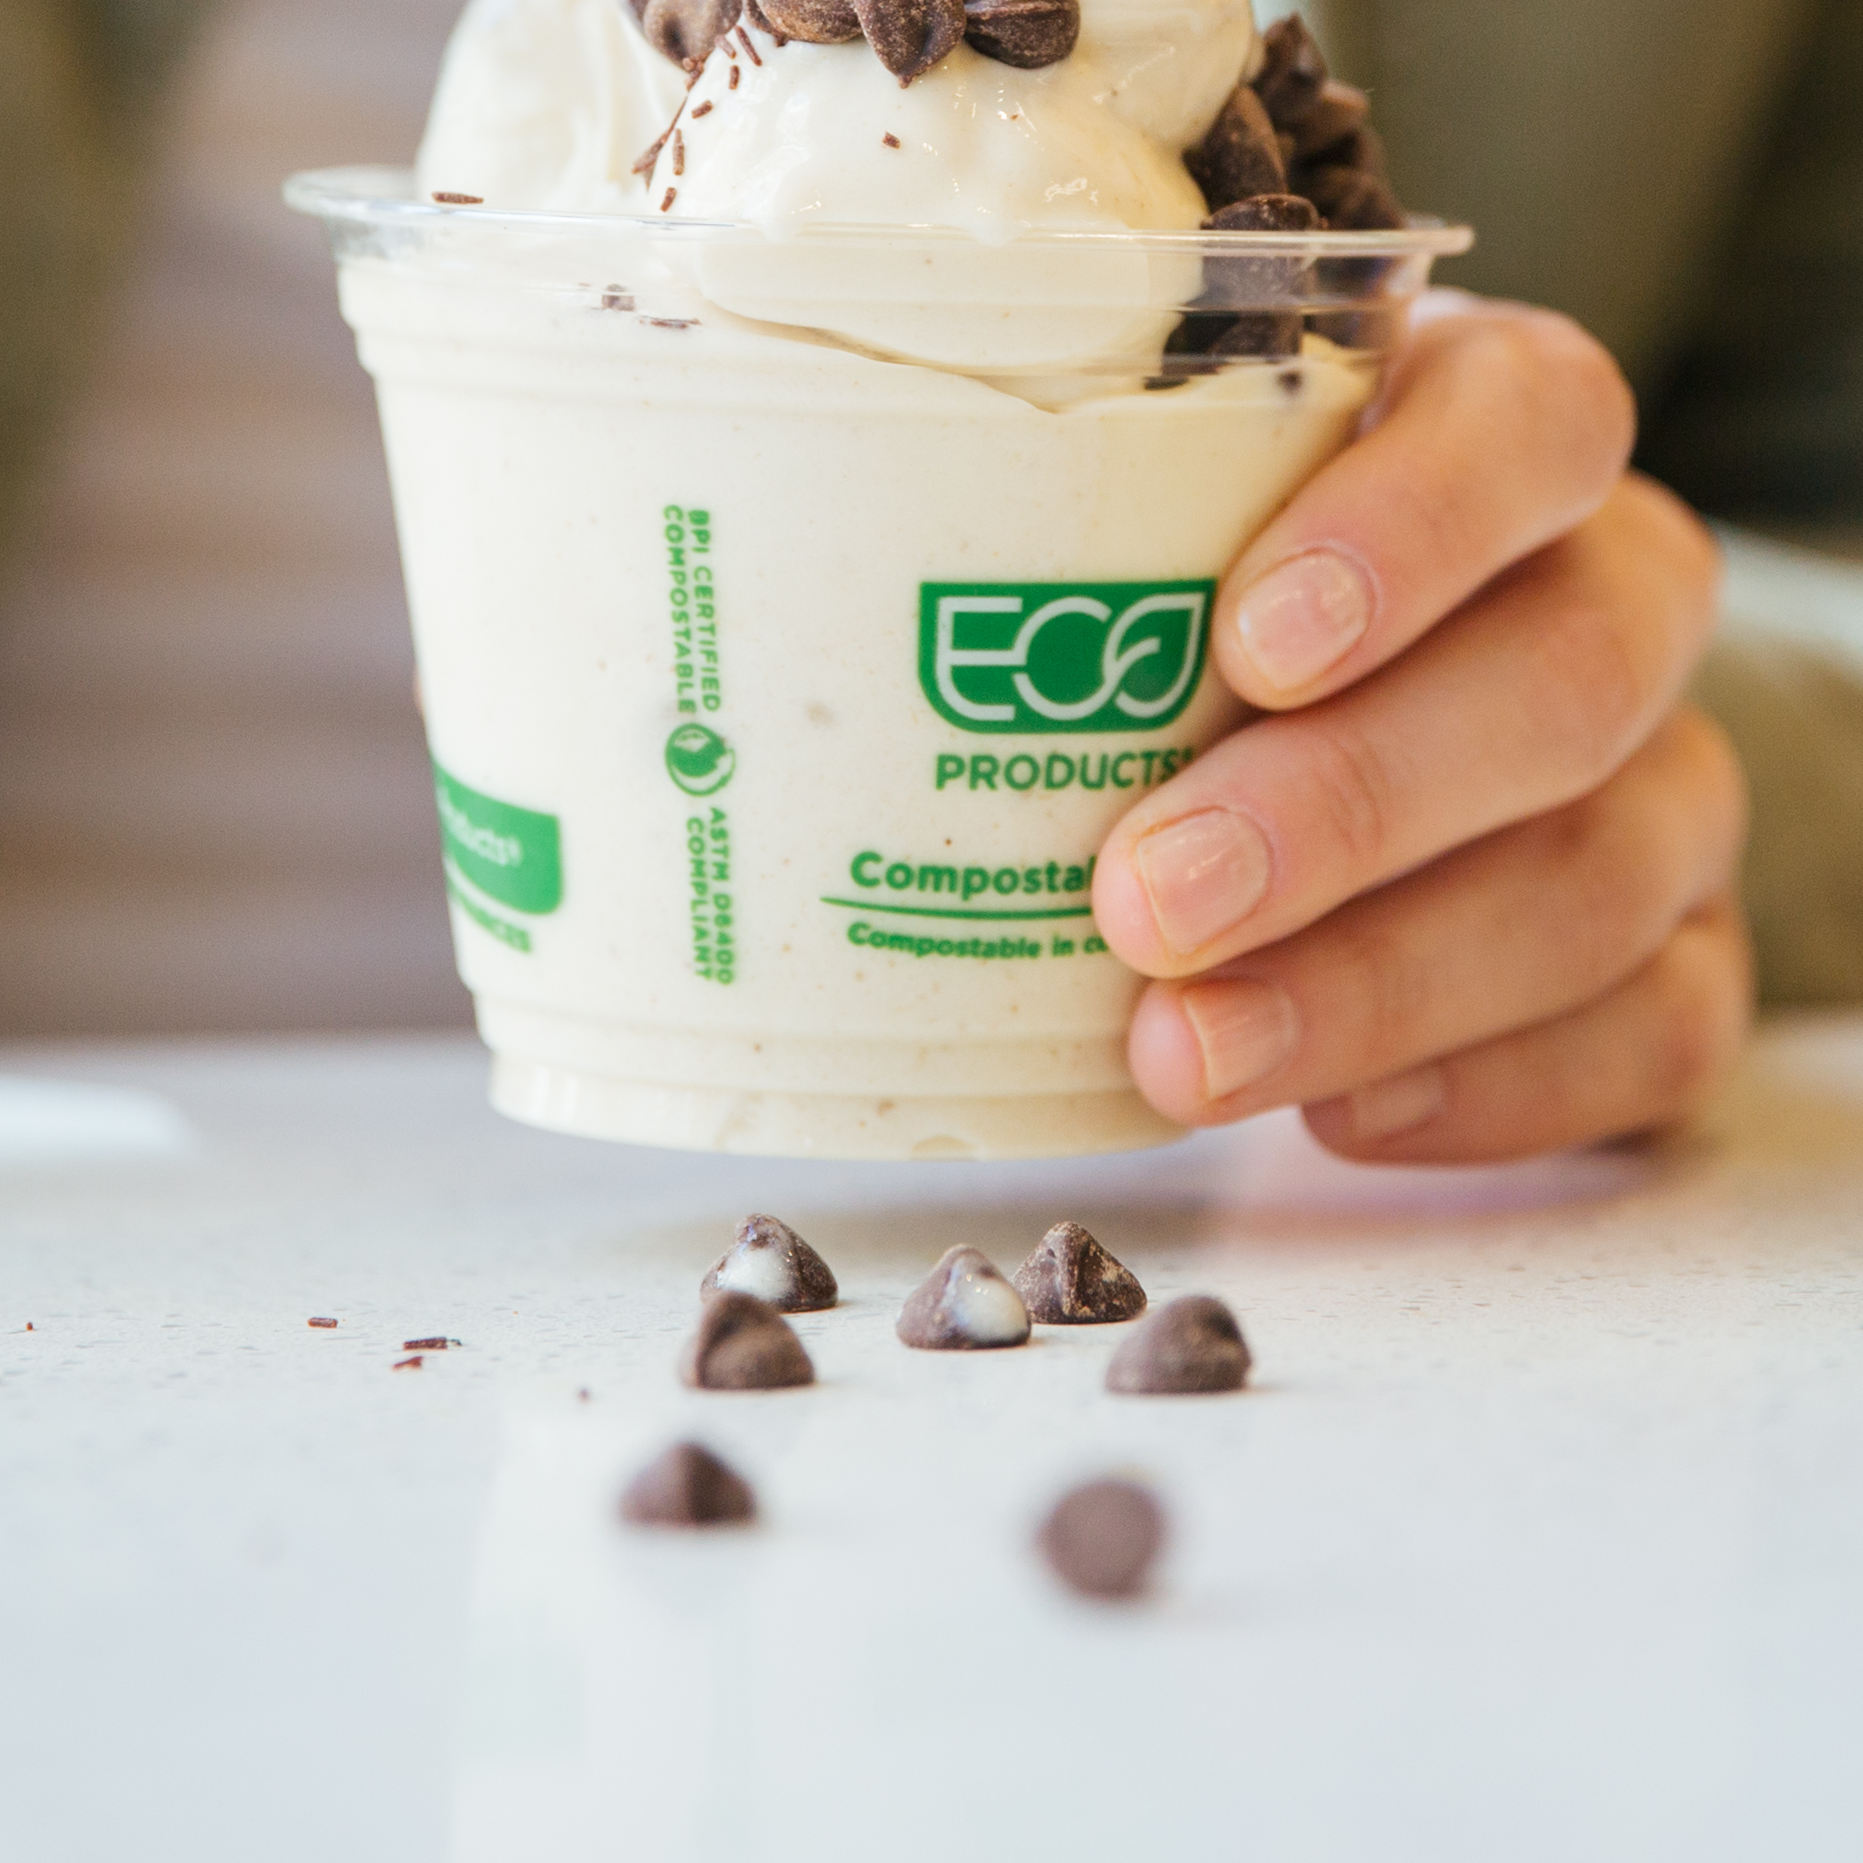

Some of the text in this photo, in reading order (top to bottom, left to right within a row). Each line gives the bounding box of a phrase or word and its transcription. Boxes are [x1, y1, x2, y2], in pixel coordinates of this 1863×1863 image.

[663, 504, 697, 714] COMPOSTABLE
[693, 566, 721, 712] CERTIFIED
[935, 592, 1206, 722] ECO
[687, 817, 713, 980] COMPLIANT
[710, 805, 730, 882] ASTM
[847, 921, 1042, 959] Compostable
[1052, 933, 1074, 957] in
